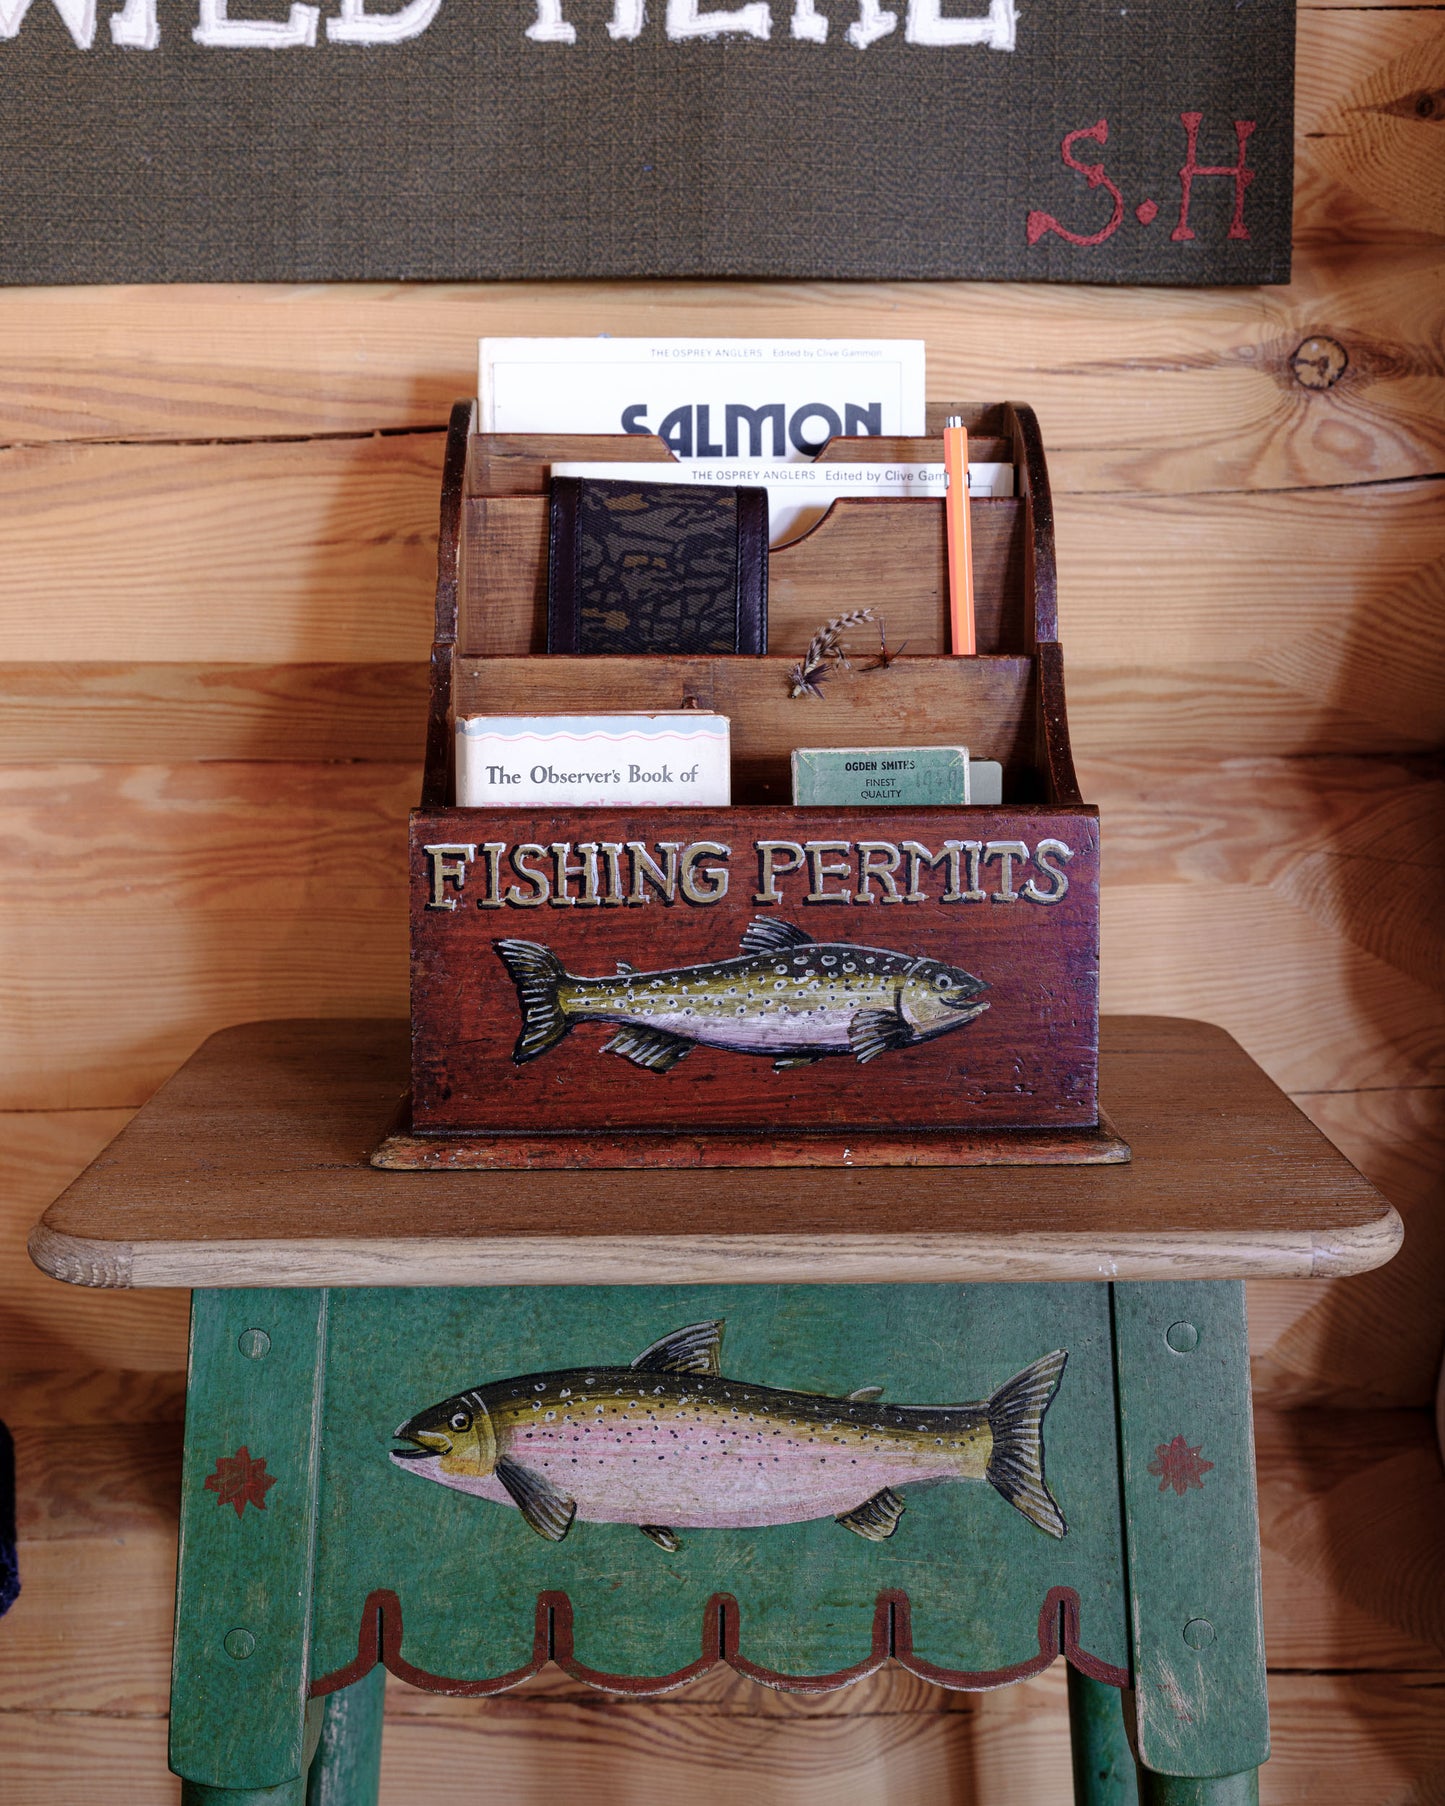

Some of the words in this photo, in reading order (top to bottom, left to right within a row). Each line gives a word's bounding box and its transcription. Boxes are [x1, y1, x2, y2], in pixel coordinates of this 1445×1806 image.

[650, 348, 669, 357] THE
[672, 348, 712, 357] OSPREY
[715, 348, 763, 357] ANGLERS
[772, 348, 801, 357] Edited
[803, 348, 814, 359] by
[816, 348, 839, 357] Clive
[841, 348, 882, 357] Gammon
[621, 402, 882, 457] SALMON
[691, 470, 713, 481] THE
[716, 470, 760, 481] OSPREY
[763, 470, 816, 480] ANGLERS
[825, 469, 863, 481] Edited
[867, 470, 881, 483] by
[885, 470, 914, 481] Clive
[844, 761, 878, 772] OGDEN
[485, 766, 522, 784] The
[530, 765, 621, 784] Observer's
[628, 764, 674, 783] Book
[680, 764, 699, 782] of
[865, 778, 897, 787] FINEST
[860, 789, 902, 799] QUALITY
[423, 841, 732, 911] FISHING
[751, 838, 1076, 906] PERMITS
